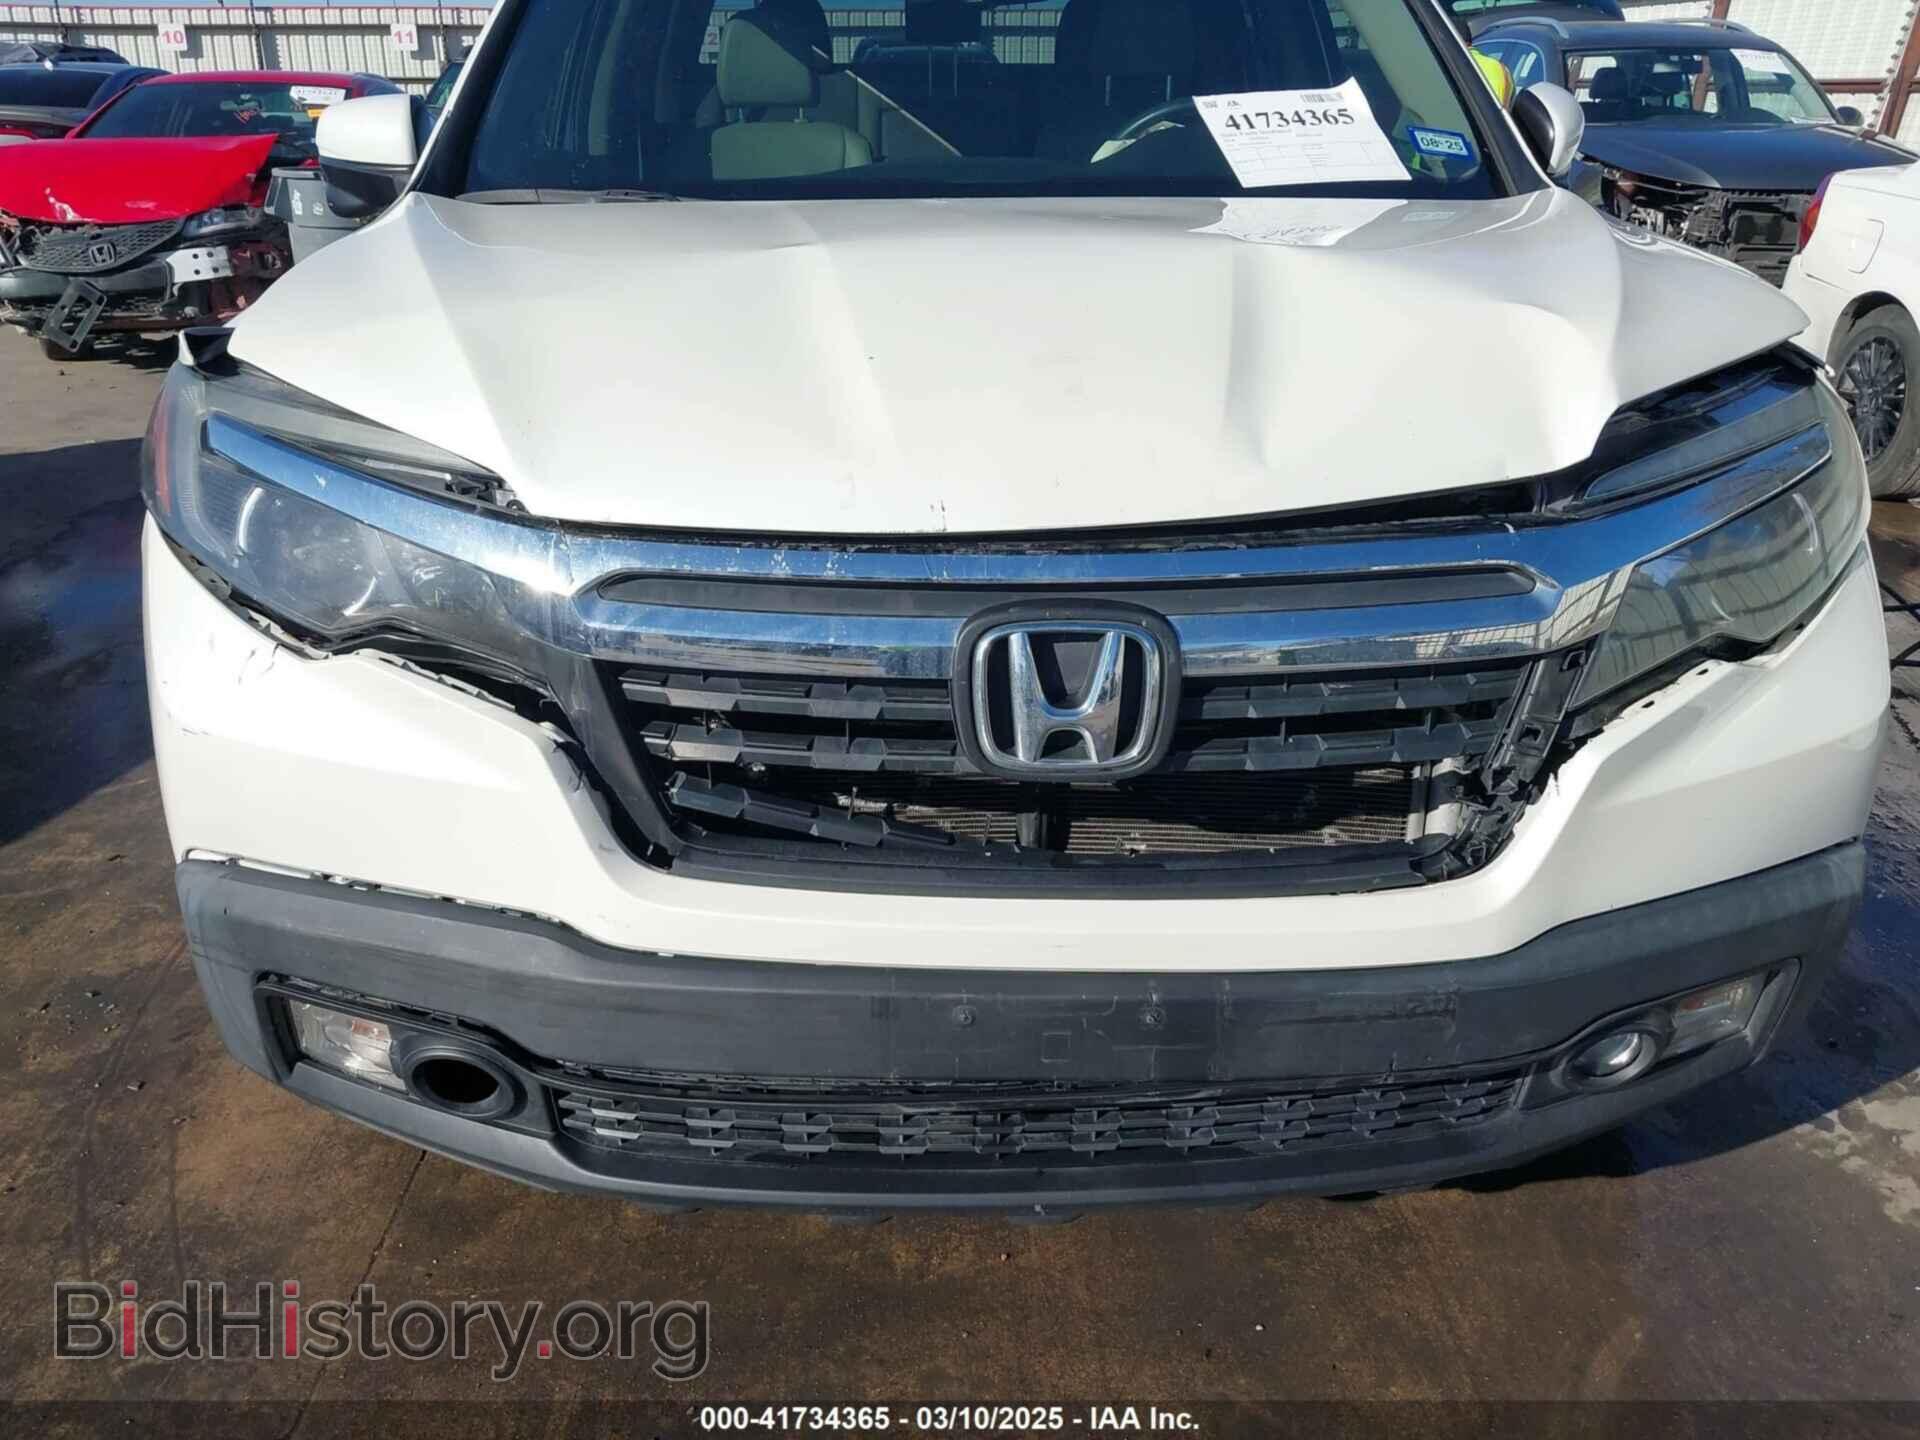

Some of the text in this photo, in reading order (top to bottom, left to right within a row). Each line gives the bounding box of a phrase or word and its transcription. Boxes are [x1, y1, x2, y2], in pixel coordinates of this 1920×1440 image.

[161, 30, 184, 44] 10
[394, 30, 414, 44] 11
[1225, 108, 1355, 131] 41734365
